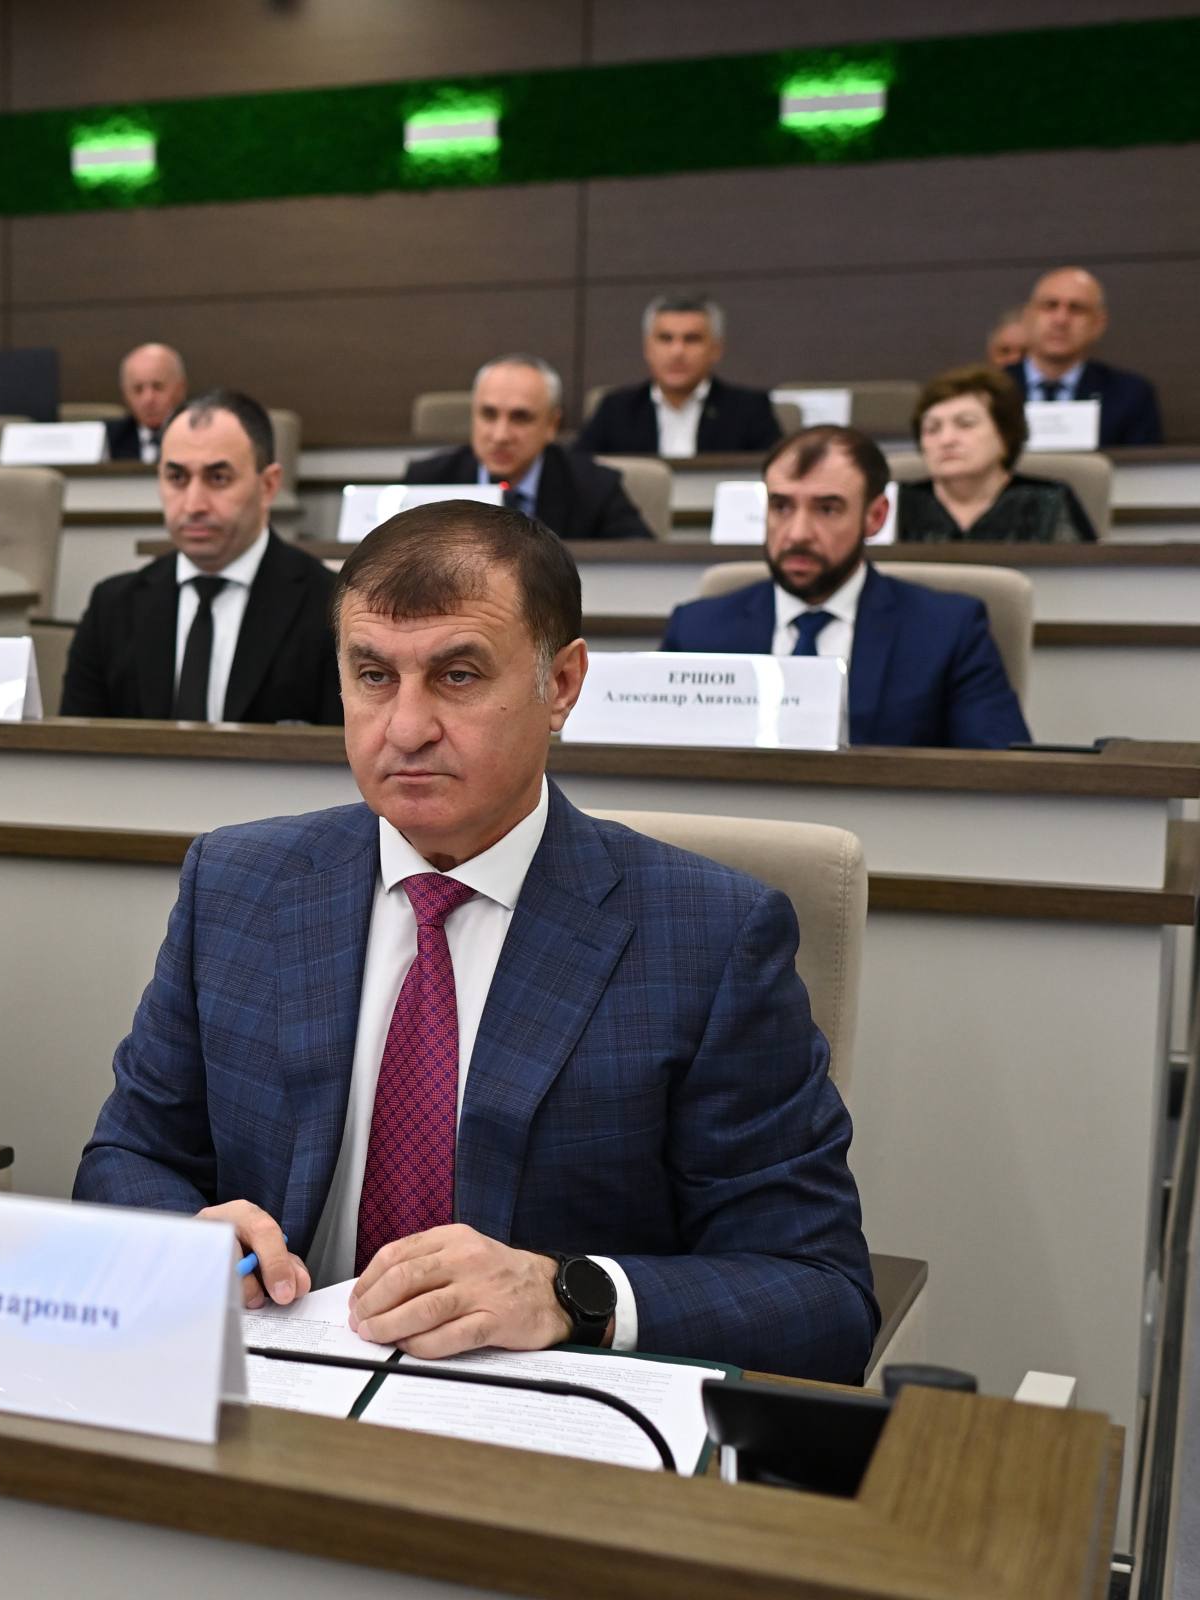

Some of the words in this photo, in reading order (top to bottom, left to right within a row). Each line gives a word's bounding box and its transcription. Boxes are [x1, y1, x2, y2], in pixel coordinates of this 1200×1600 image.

[667, 672, 736, 686] ЕРШОВ
[603, 691, 688, 707] Александр
[695, 692, 801, 707] Анатольич
